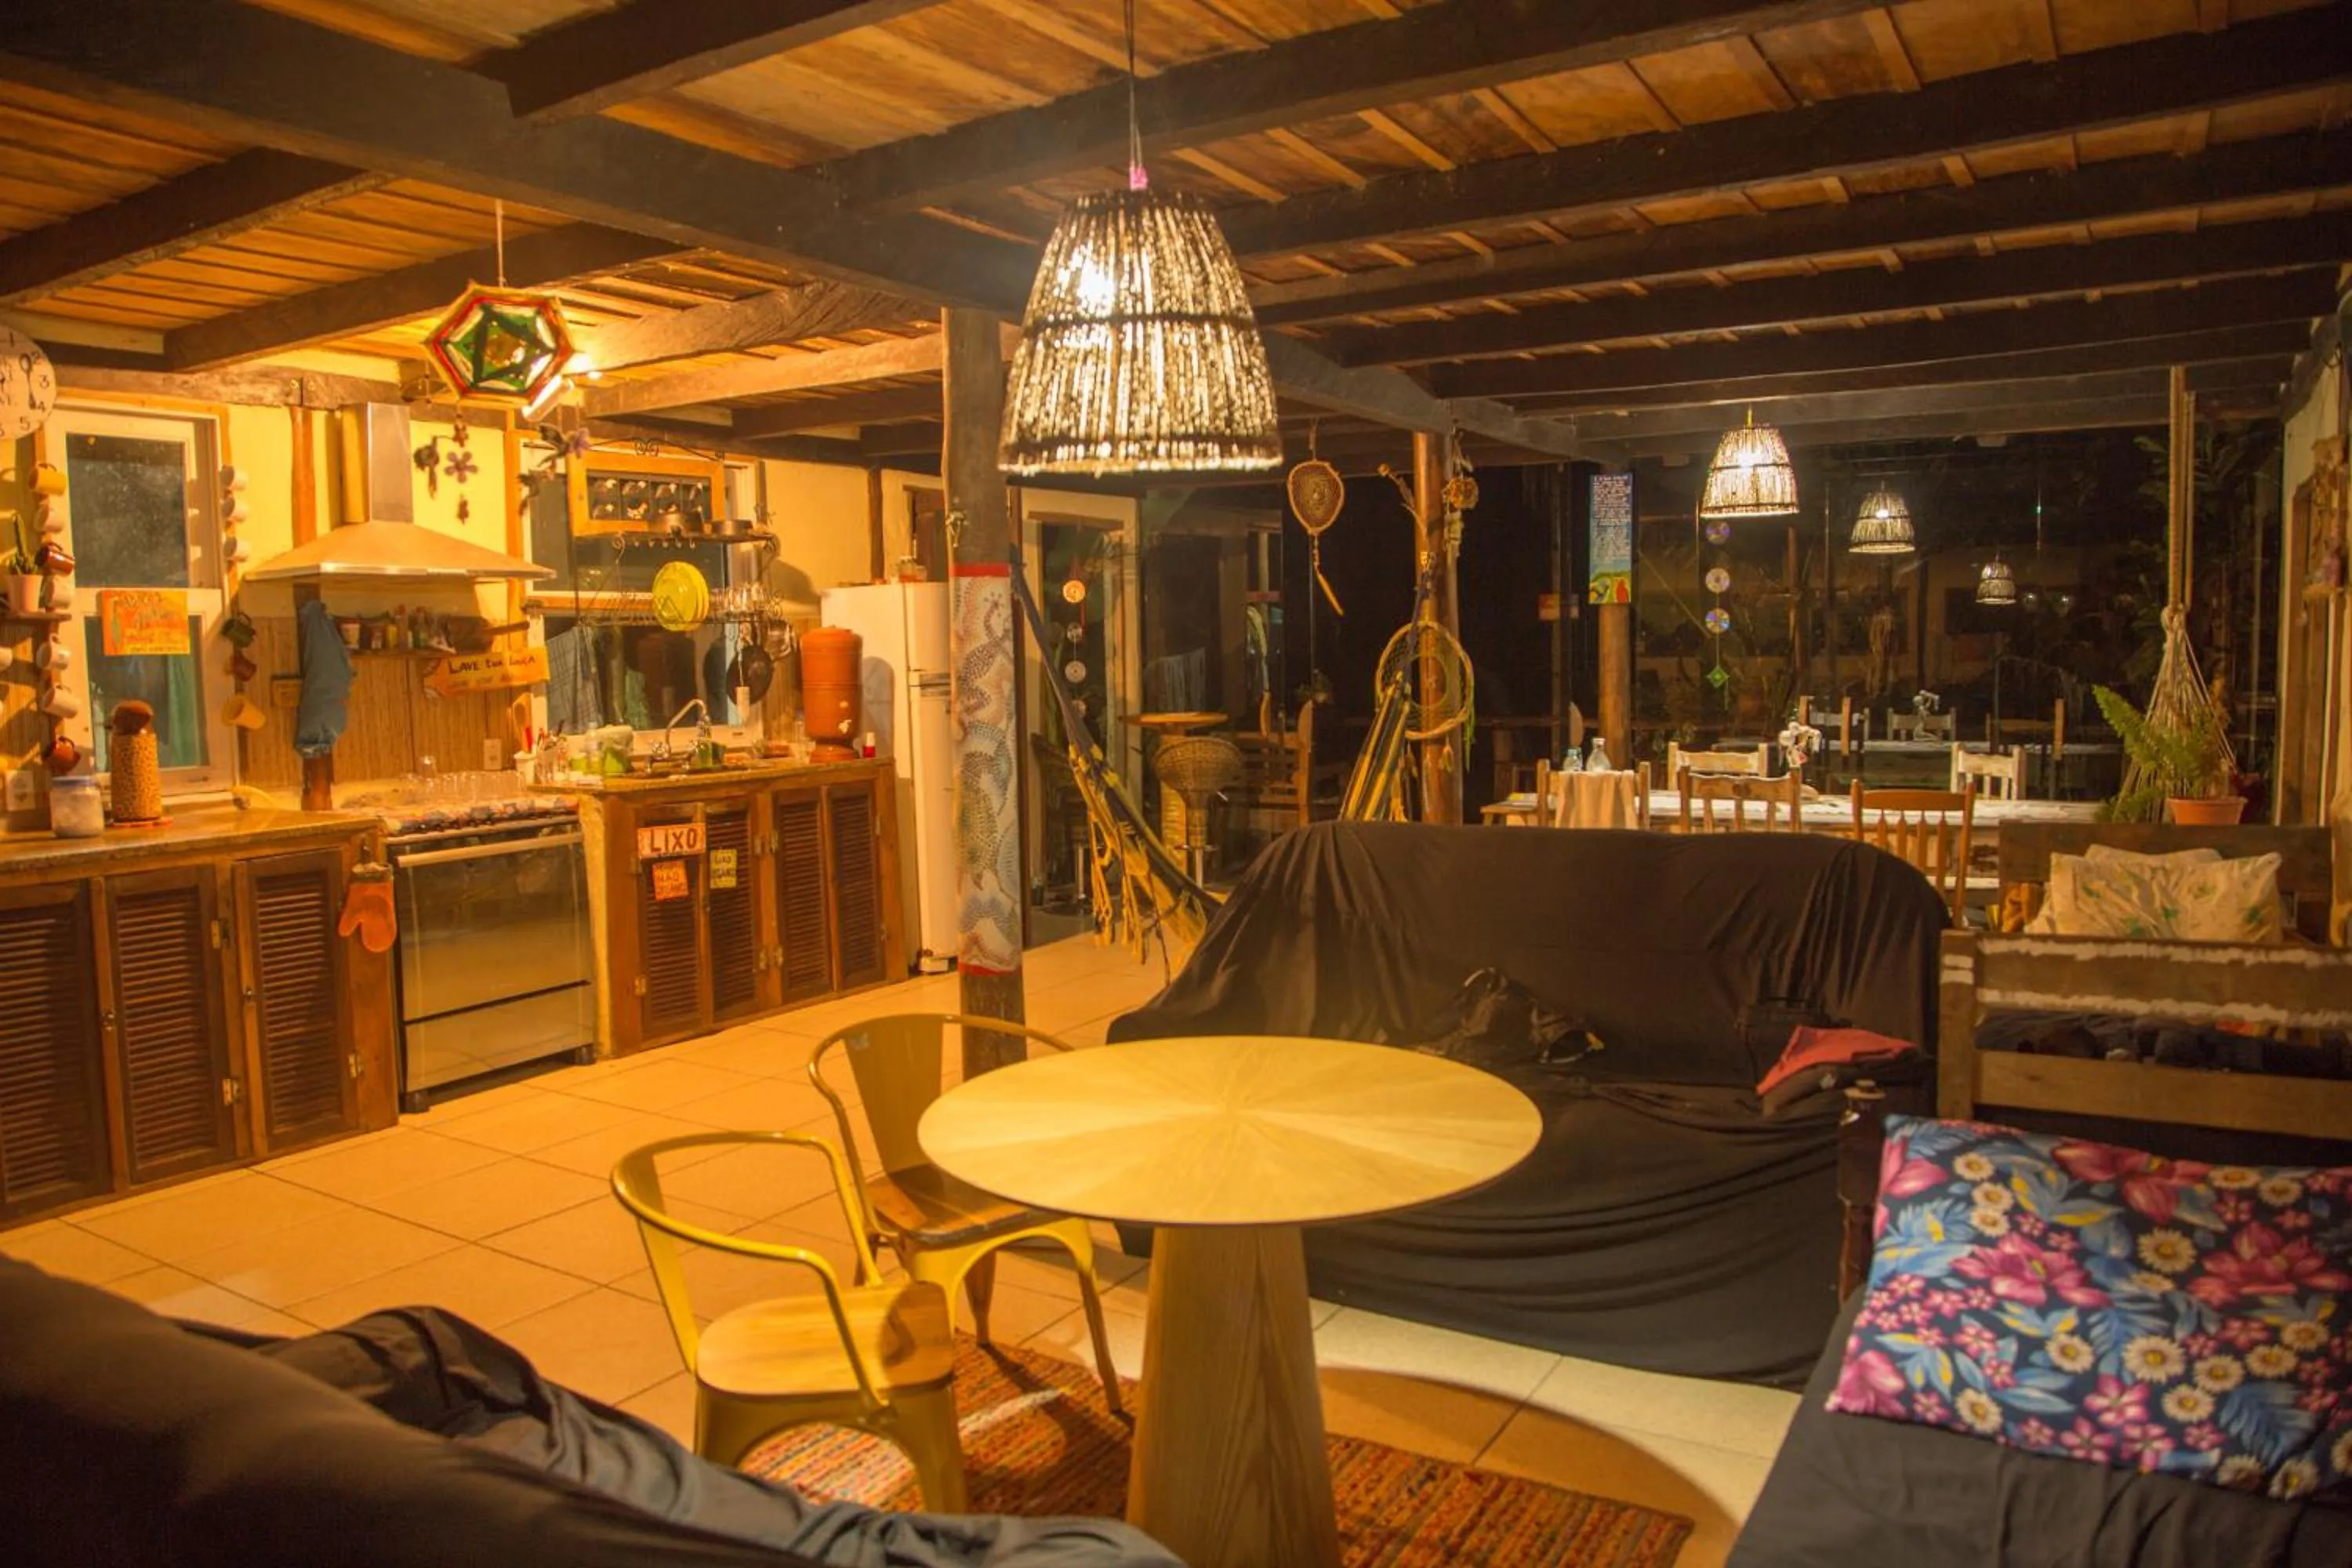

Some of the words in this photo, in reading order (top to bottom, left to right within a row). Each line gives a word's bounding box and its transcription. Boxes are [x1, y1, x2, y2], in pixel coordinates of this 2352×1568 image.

[39, 374, 49, 389] 3
[20, 416, 31, 431] 5
[650, 828, 697, 853] LIXO
